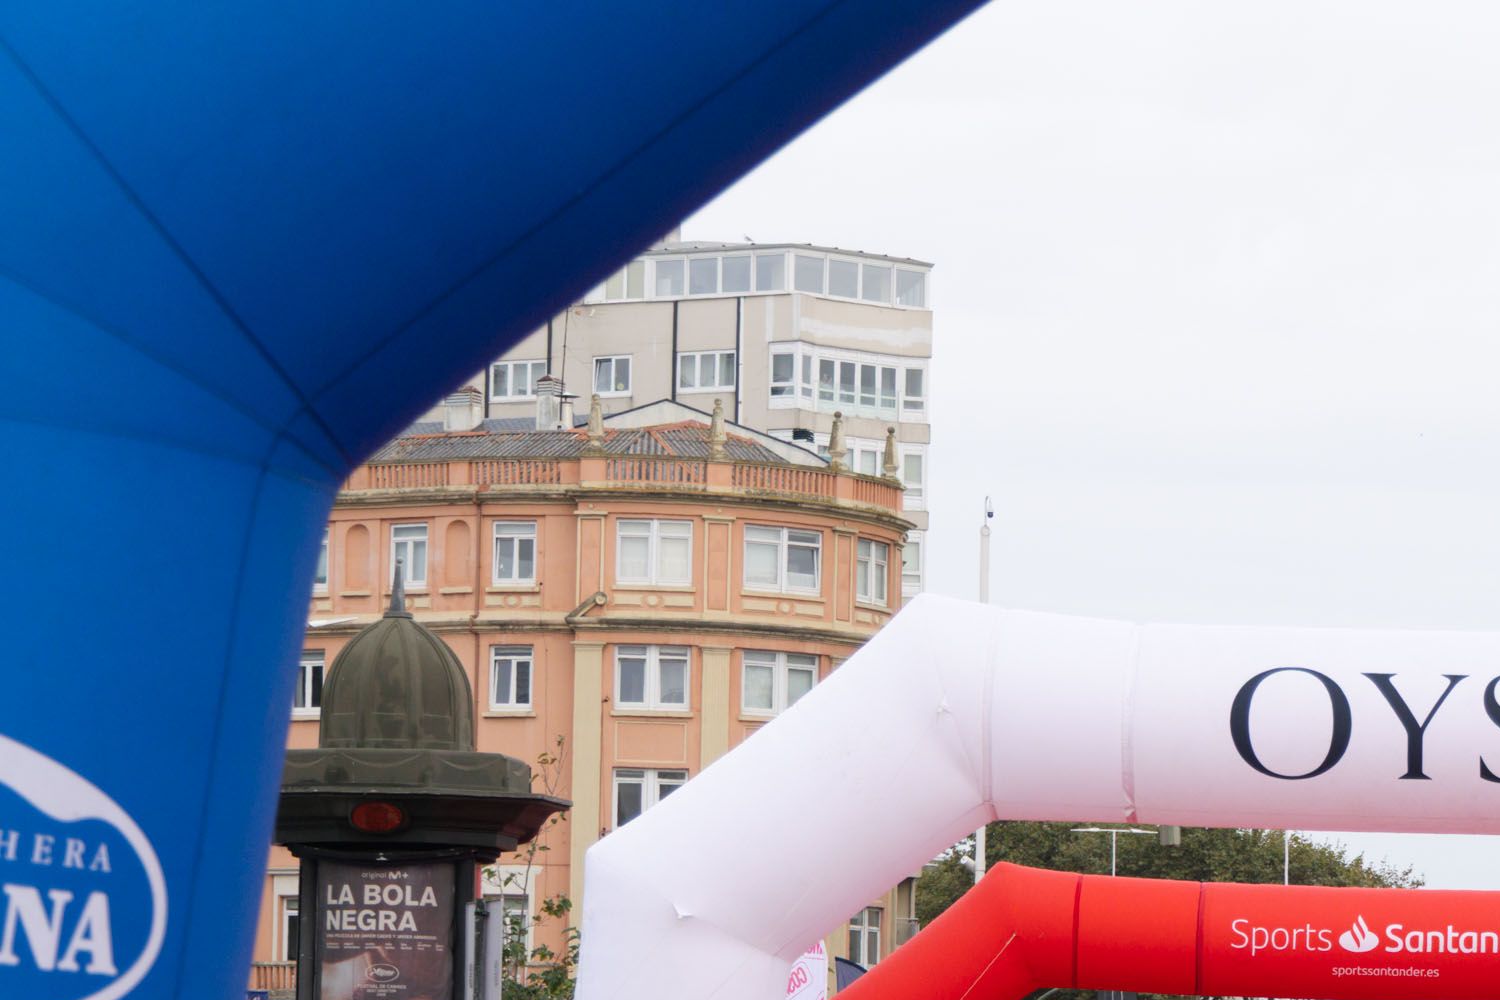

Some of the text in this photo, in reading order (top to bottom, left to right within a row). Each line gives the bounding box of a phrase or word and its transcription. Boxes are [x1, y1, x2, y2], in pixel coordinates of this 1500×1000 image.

[326, 883, 438, 907] LA BOLA
[0, 883, 118, 976] NA
[325, 909, 418, 931] NEGRA
[1230, 918, 1333, 957] Sports
[1332, 964, 1440, 978] sportssantander.es
